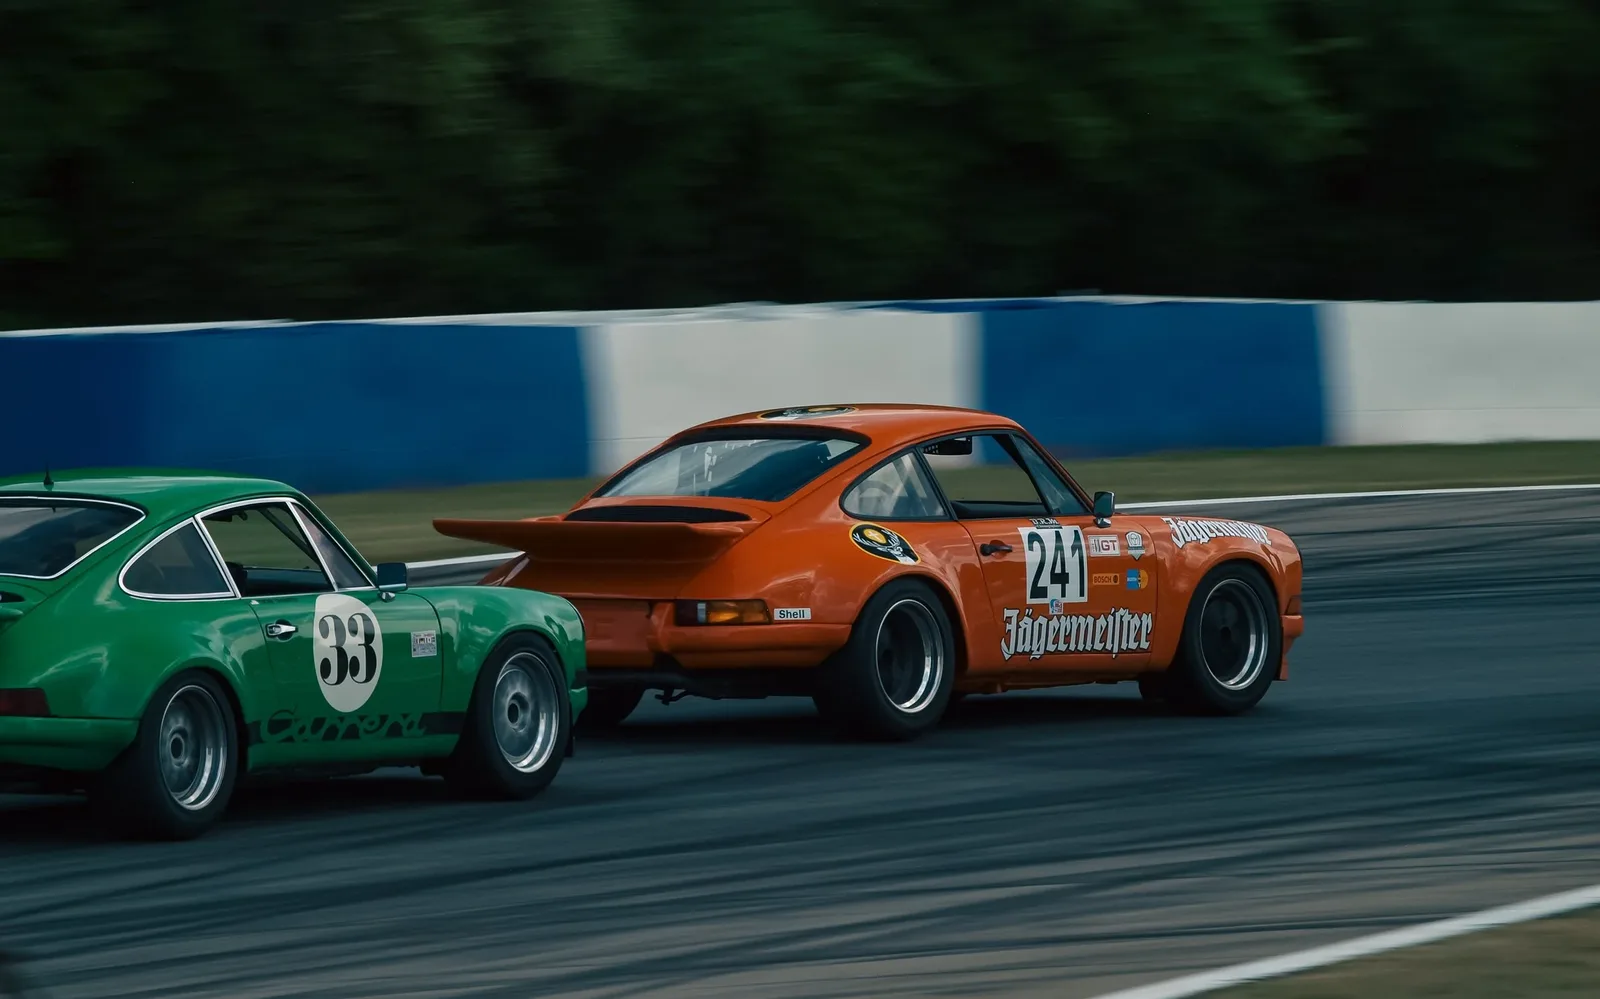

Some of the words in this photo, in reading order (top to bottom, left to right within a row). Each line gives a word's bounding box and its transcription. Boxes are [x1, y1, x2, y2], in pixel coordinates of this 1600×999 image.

[1027, 529, 1086, 600] 241
[1093, 575, 1112, 584] BOSCH
[779, 609, 805, 619] Shell
[1001, 607, 1152, 660] Jägermeister
[318, 612, 377, 686] 33
[260, 705, 426, 743] Carrera
